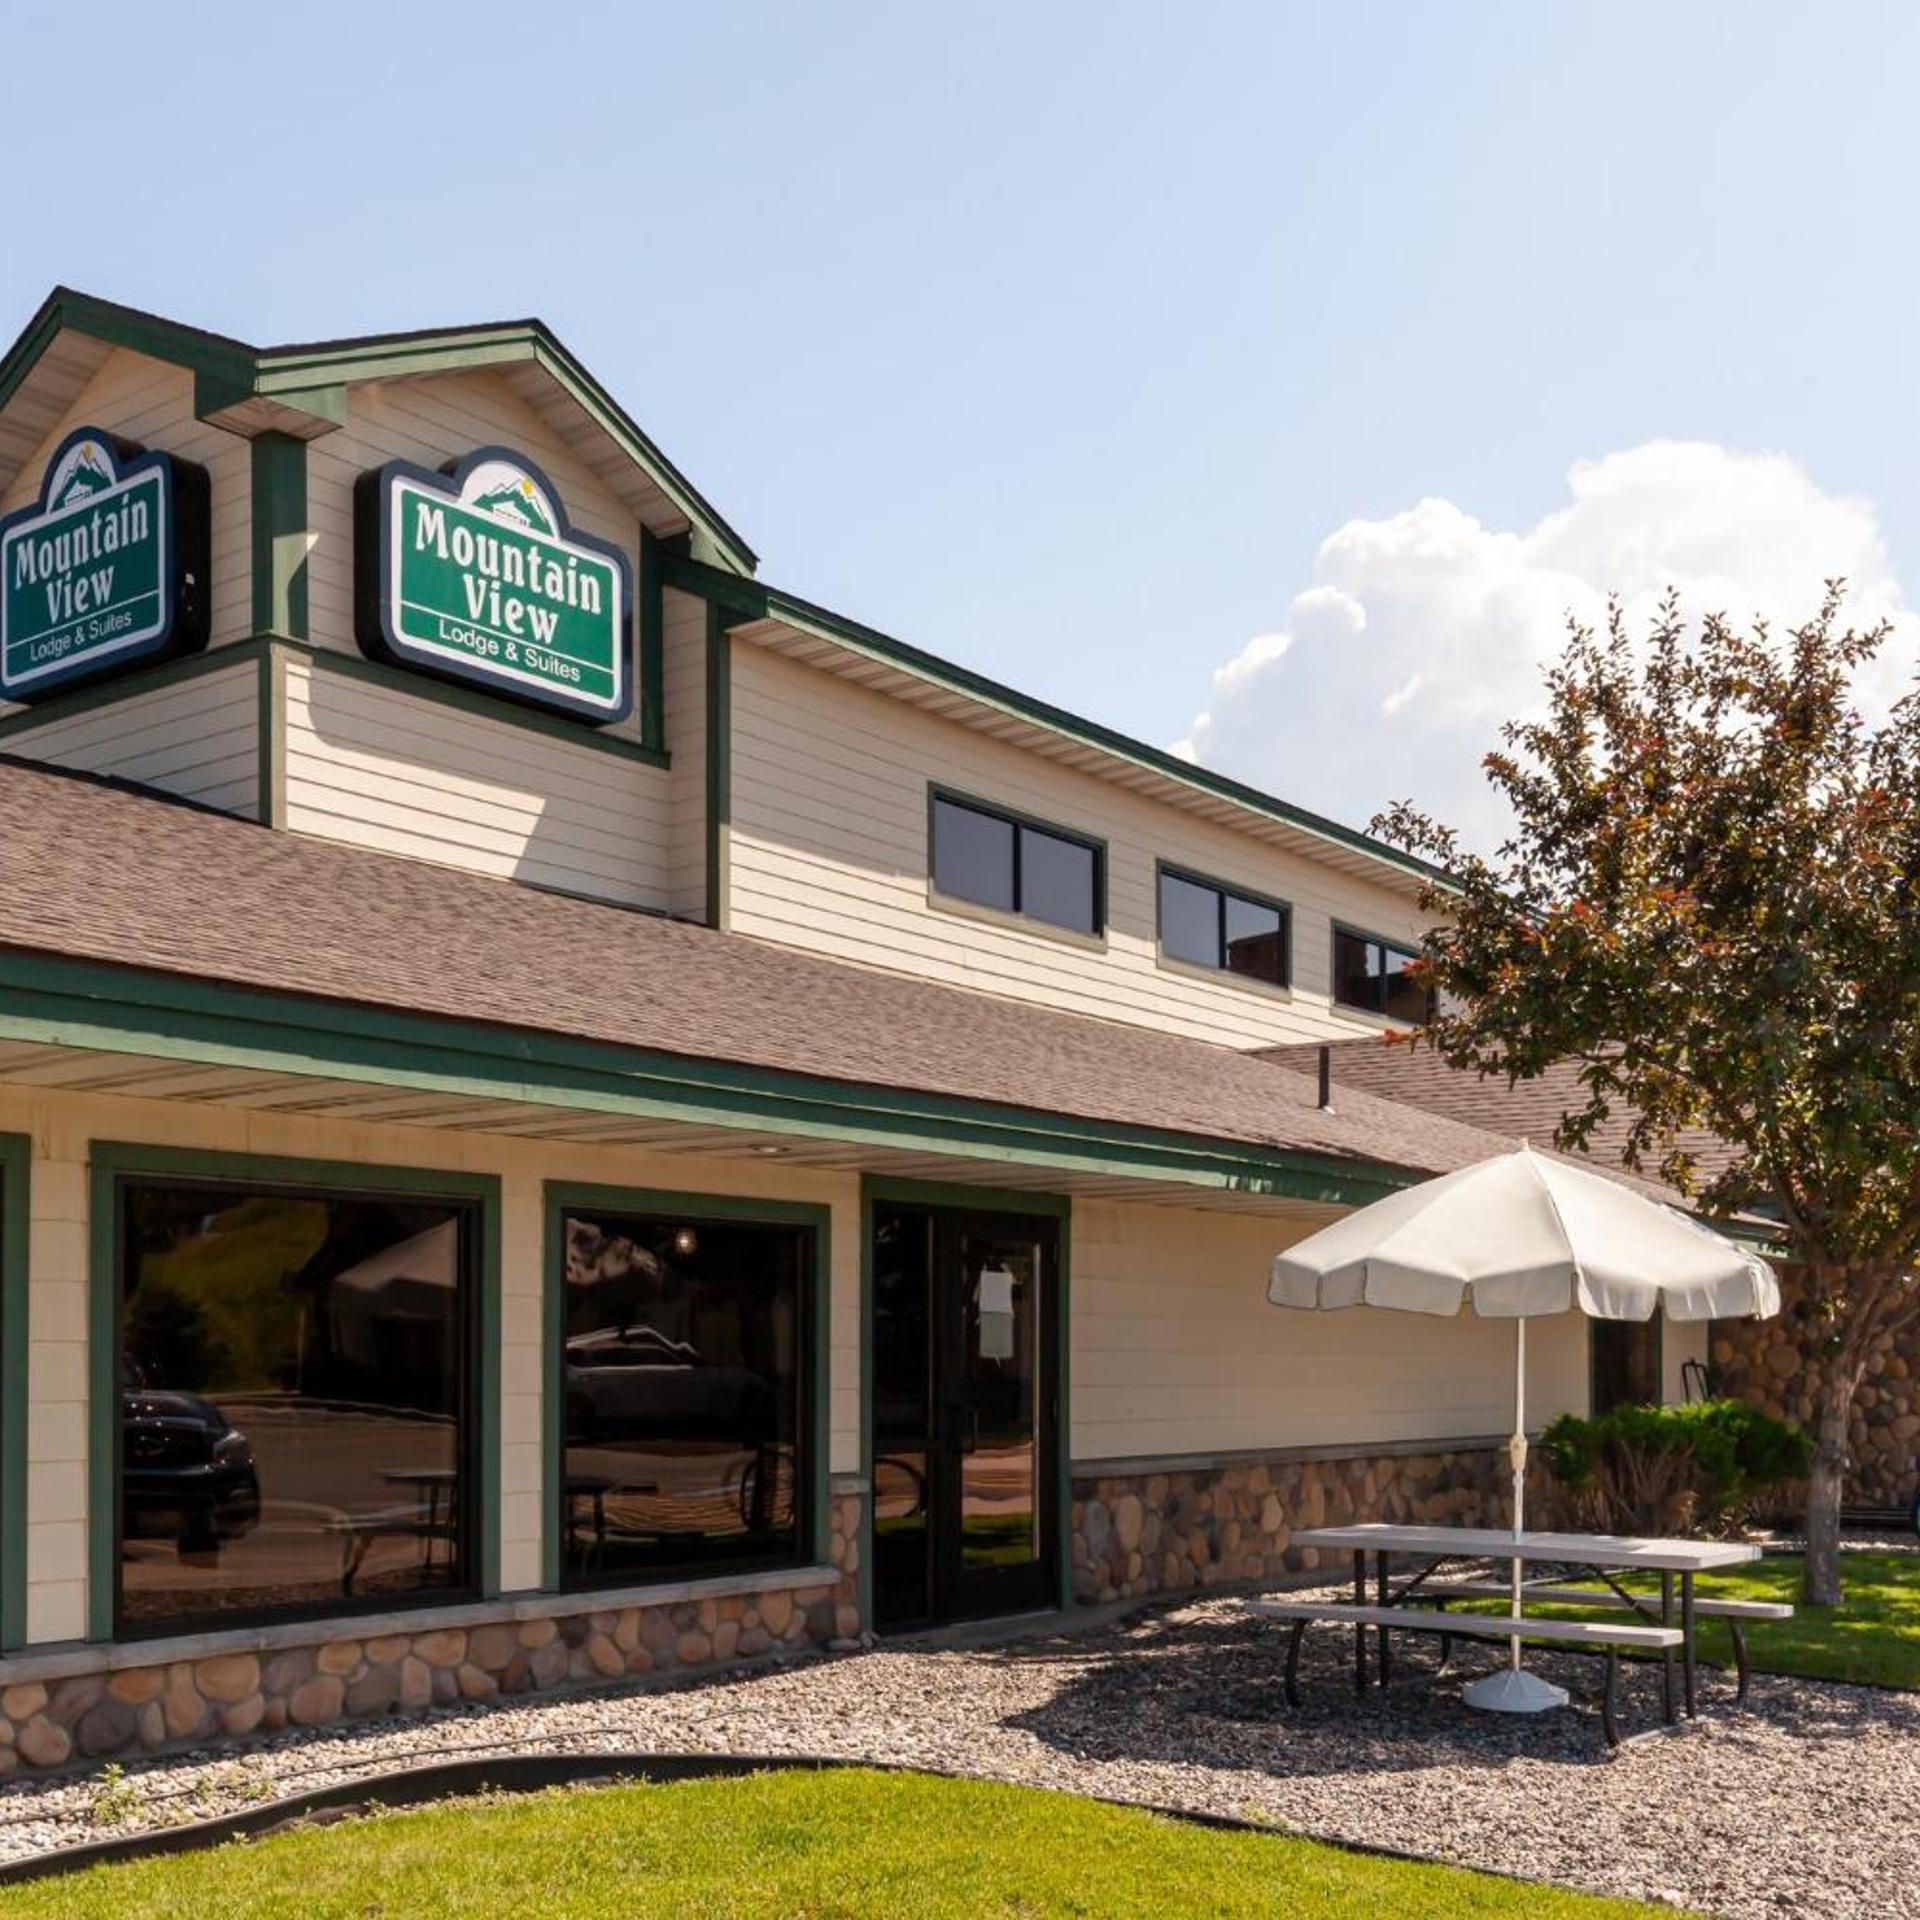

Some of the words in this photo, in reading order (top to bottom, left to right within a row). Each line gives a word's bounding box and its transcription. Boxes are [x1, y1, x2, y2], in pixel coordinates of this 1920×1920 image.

[15, 492, 149, 590] Mountain
[415, 503, 601, 615] Mountain
[46, 566, 115, 624] View
[463, 573, 559, 644] View
[30, 631, 71, 662] Lodge
[74, 624, 85, 645] &
[90, 611, 132, 638] Suites
[439, 619, 500, 656] Lodge
[504, 641, 519, 662] &
[525, 648, 581, 682] Suites
